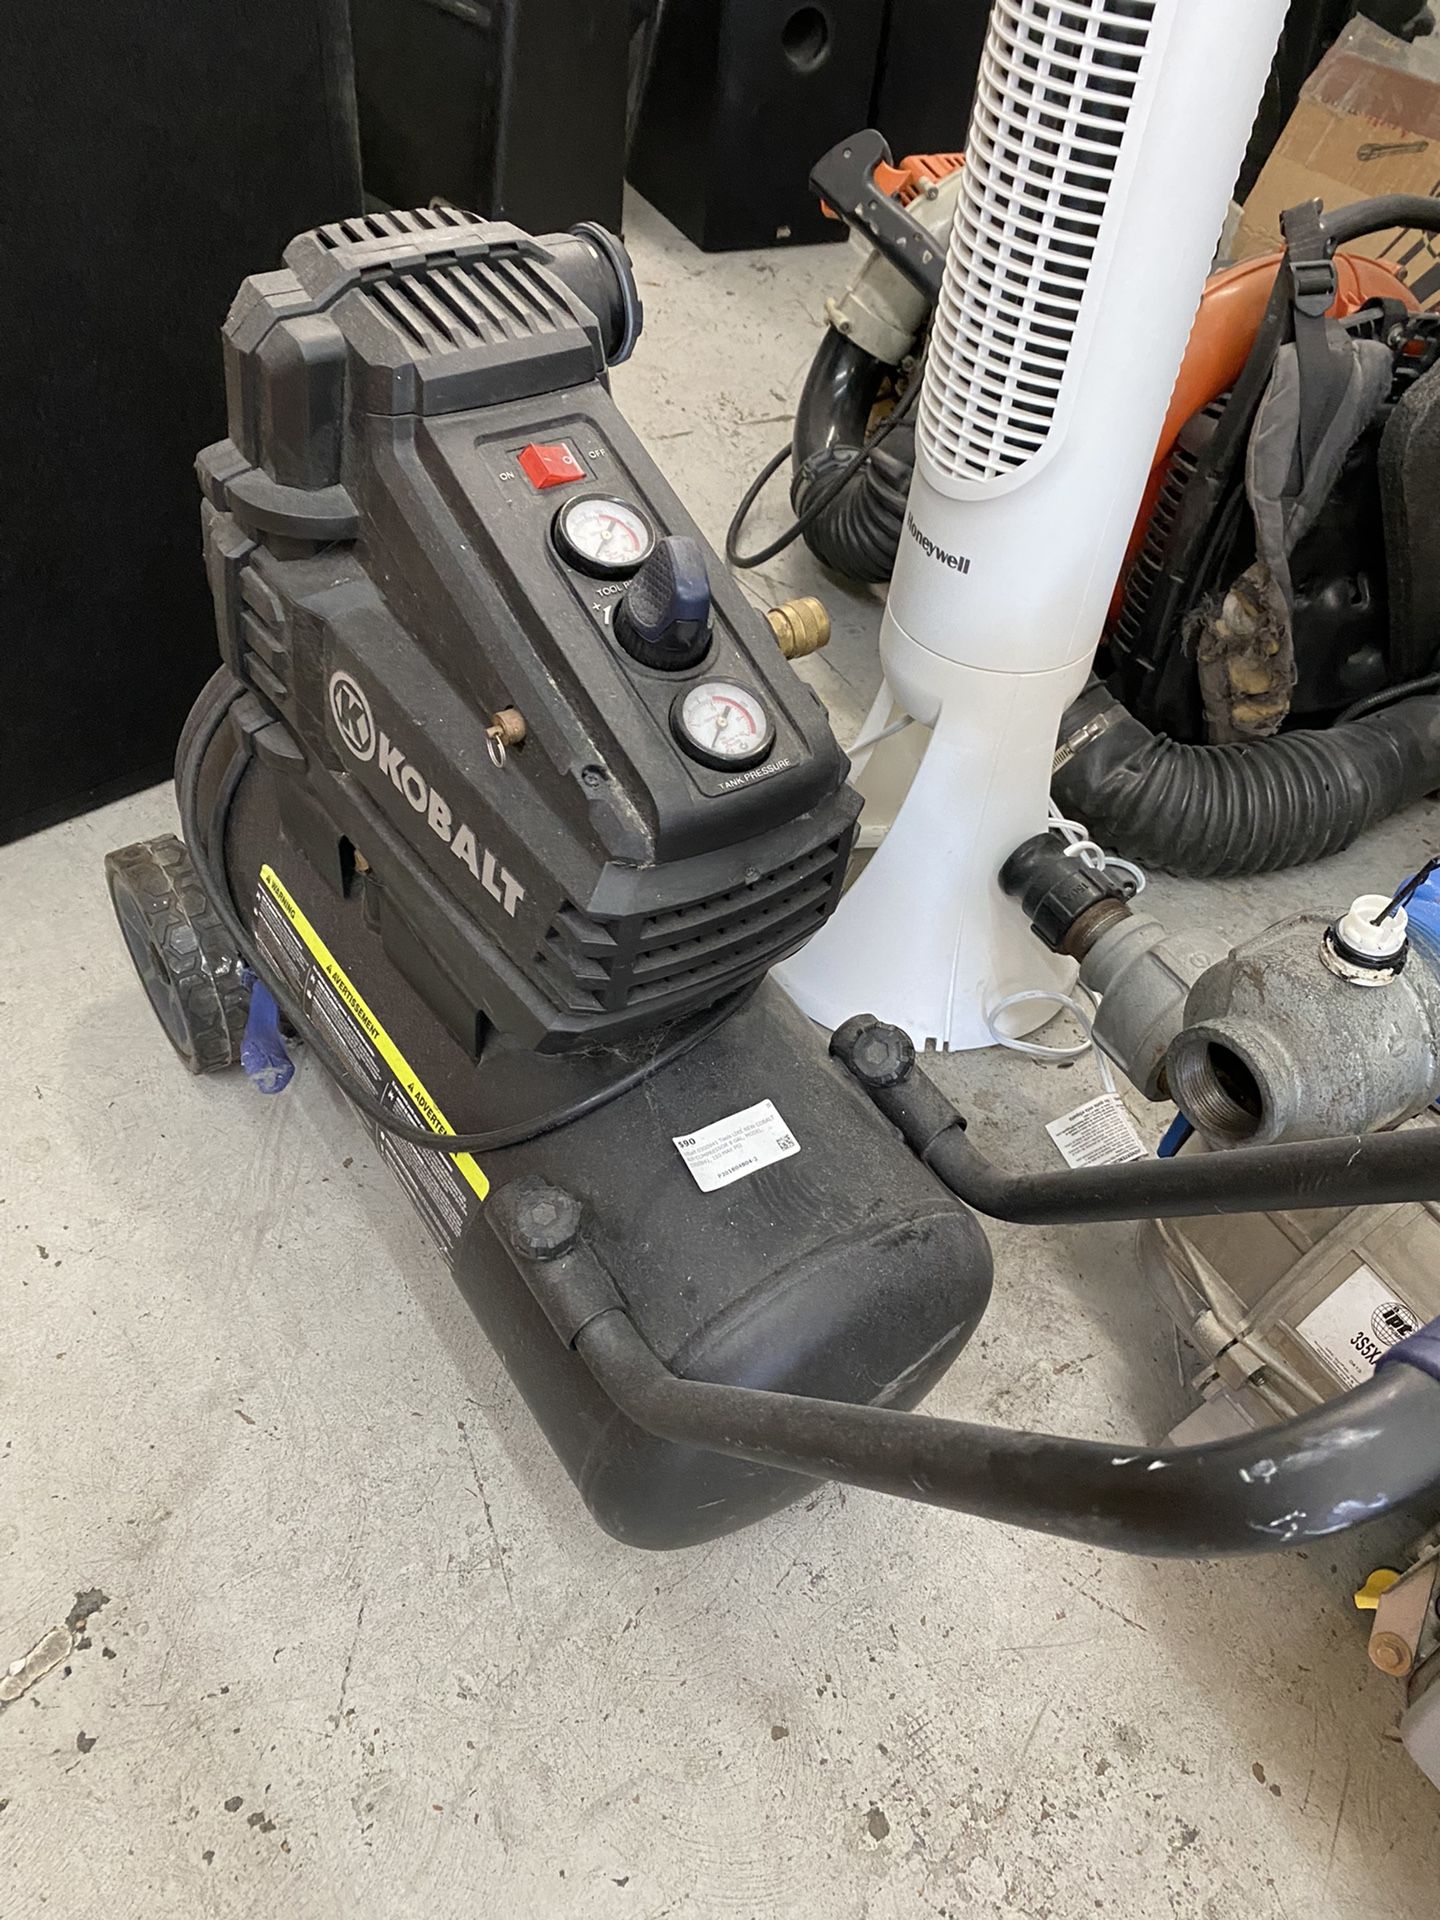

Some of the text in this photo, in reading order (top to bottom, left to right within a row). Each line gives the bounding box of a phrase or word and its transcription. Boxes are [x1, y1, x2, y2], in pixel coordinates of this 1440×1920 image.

[589, 449, 606, 460] OFF
[499, 471, 516, 482] ON
[907, 512, 970, 574] Honeywell
[597, 584, 623, 597] TOOL
[718, 758, 791, 791] TANK PRESSURE
[379, 731, 525, 918] KOBALT
[271, 883, 296, 919] WARNING
[332, 973, 380, 1039] AVERTISSEMENT
[414, 1092, 449, 1135] ADVERTEN
[678, 1138, 696, 1148] $90
[1382, 1306, 1412, 1336] ipt
[1350, 1331, 1381, 1365] 3S5X
